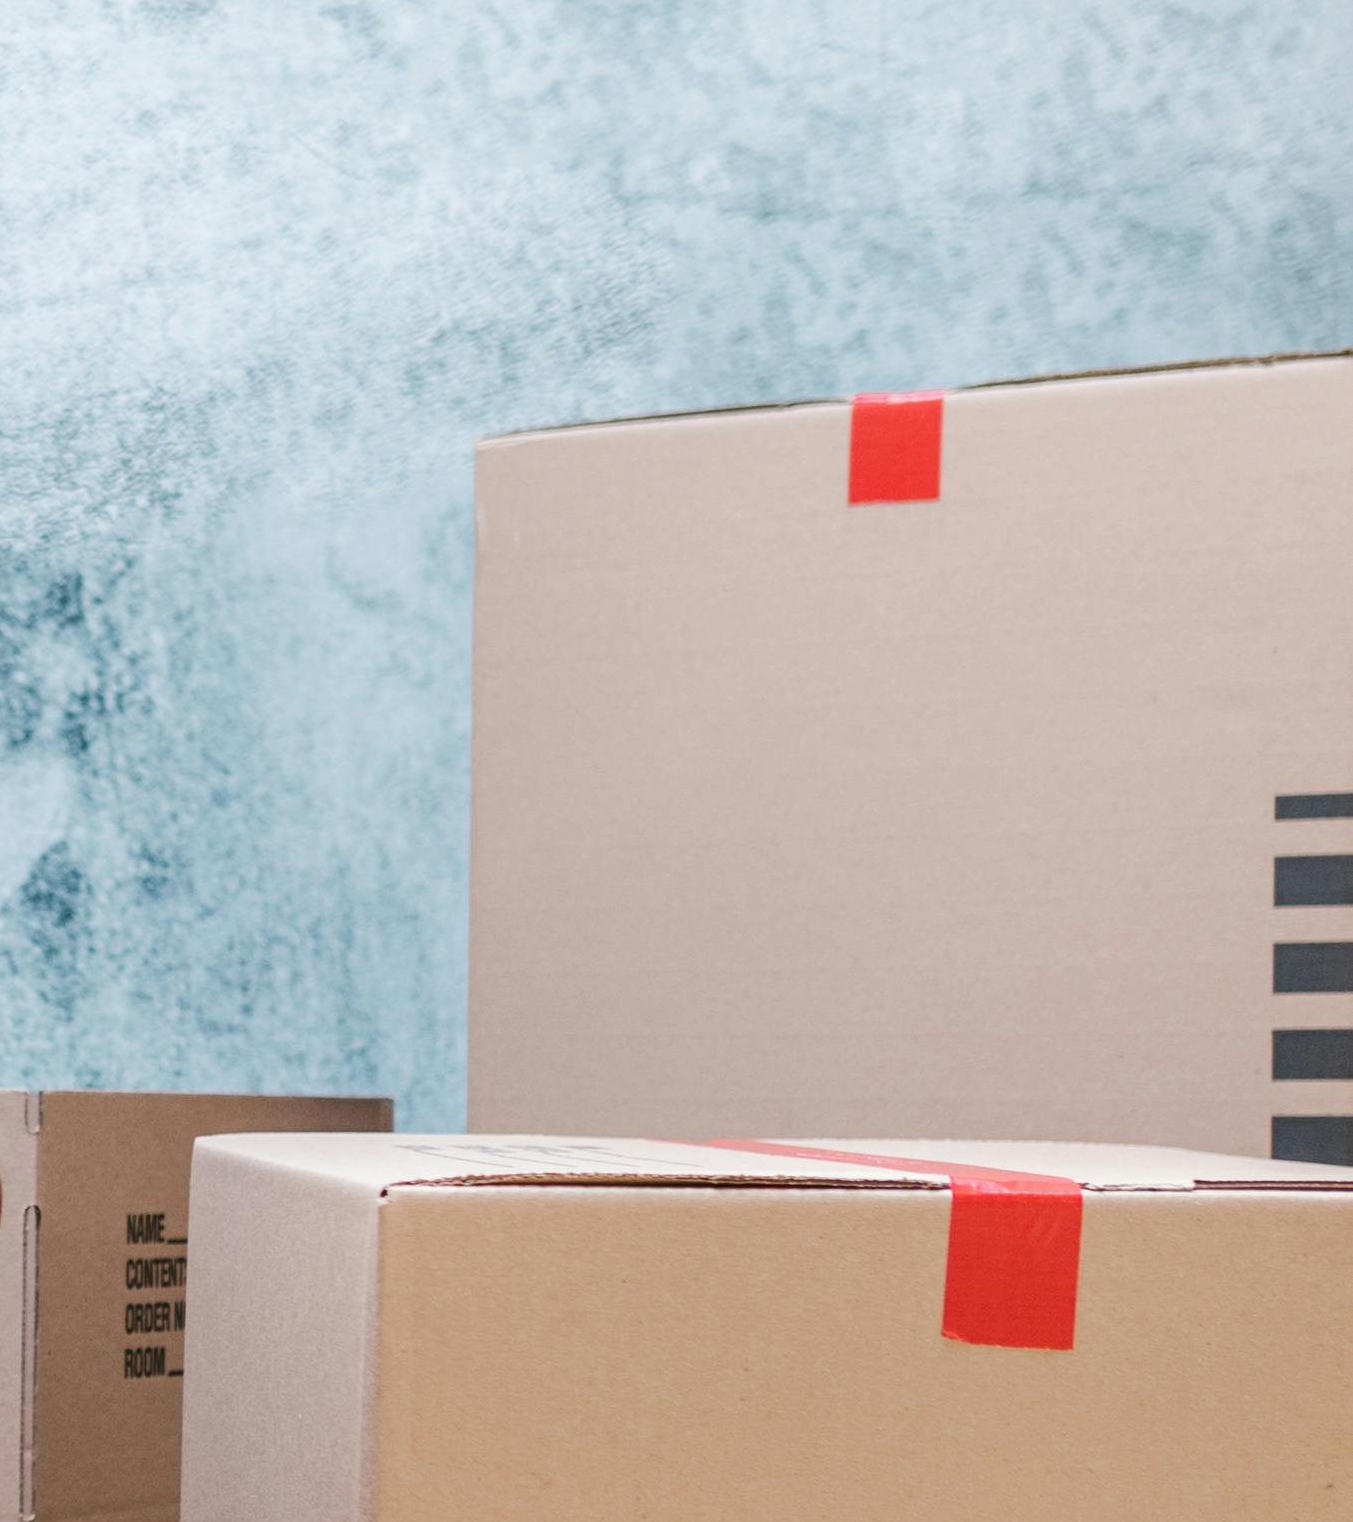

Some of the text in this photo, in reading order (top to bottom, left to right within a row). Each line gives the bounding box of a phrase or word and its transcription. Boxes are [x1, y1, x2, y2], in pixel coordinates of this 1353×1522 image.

[126, 1213, 166, 1244] NAME
[125, 1301, 170, 1335] ORDER
[124, 1346, 166, 1379] ROOM
